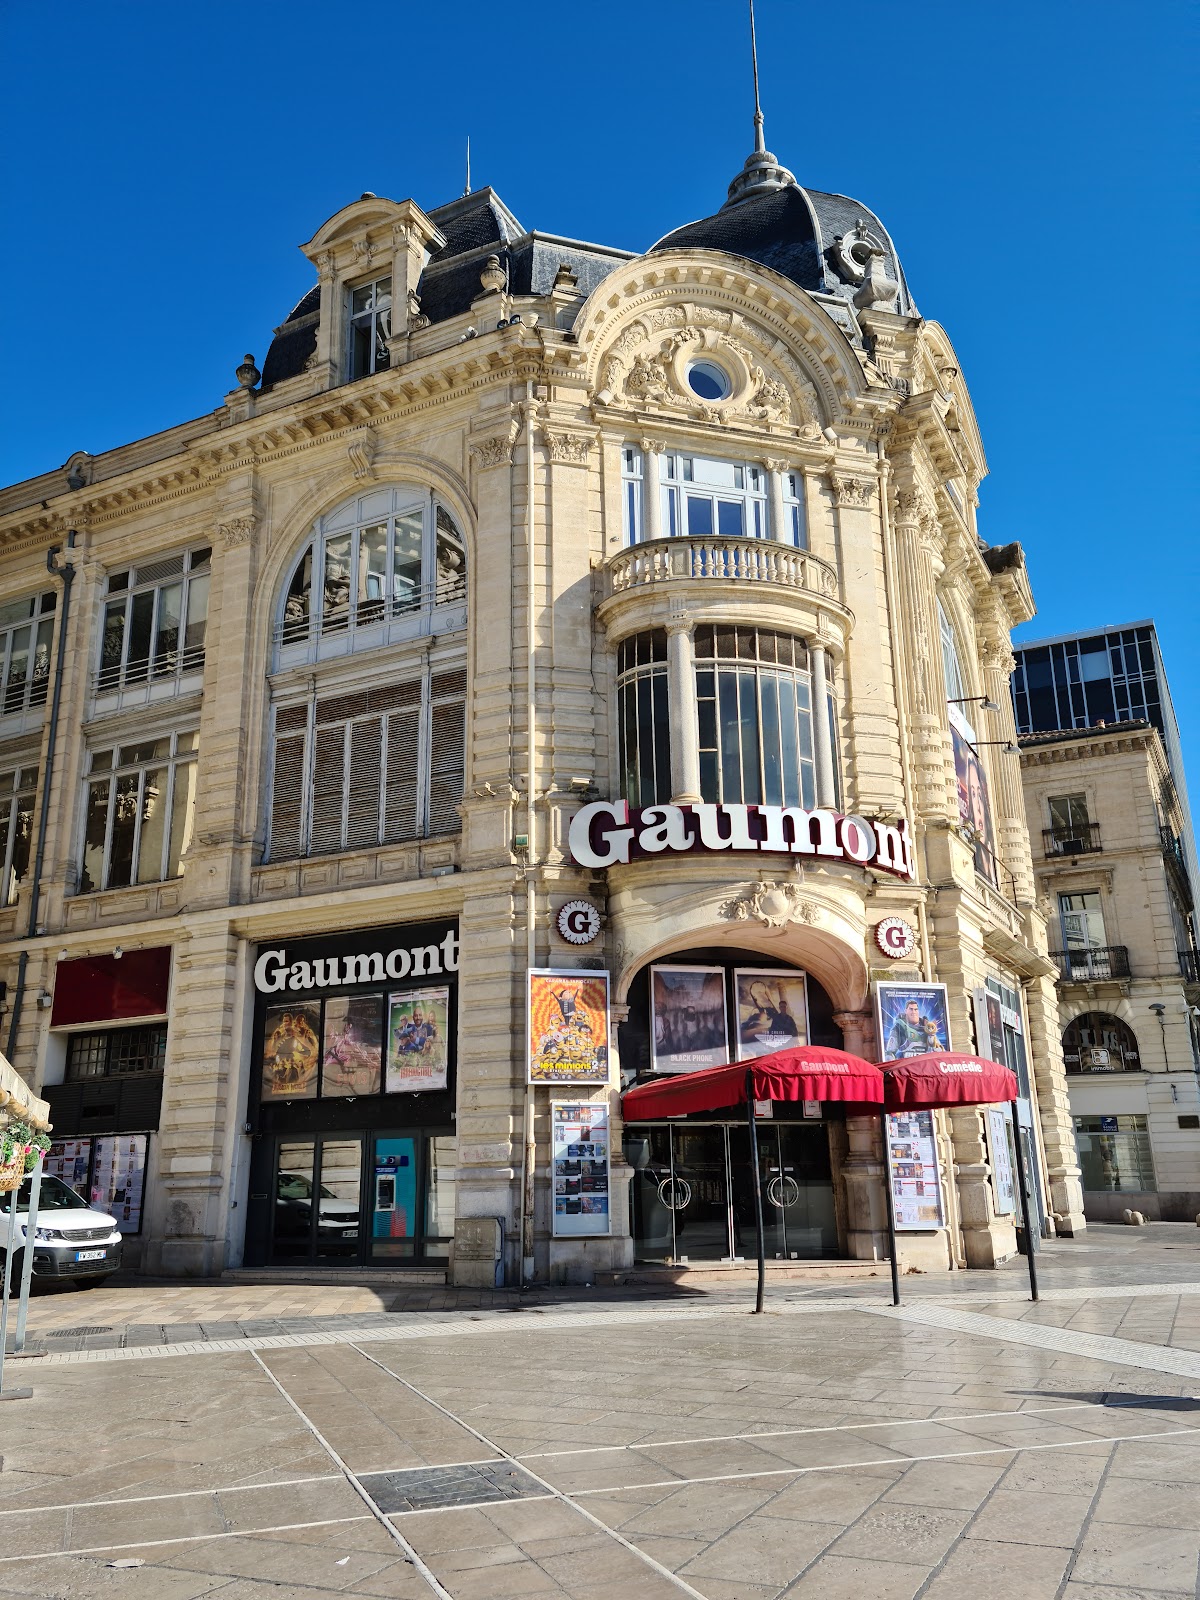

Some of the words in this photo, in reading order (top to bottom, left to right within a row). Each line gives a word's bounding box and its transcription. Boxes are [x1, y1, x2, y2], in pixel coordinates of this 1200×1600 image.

[568, 799, 917, 881] Gaumont
[567, 911, 592, 934] G
[885, 926, 907, 948] G
[254, 930, 459, 993] Gaumont
[555, 1062, 592, 1070] minions
[800, 1060, 850, 1073] Gaumont
[939, 1060, 983, 1073] Comédie
